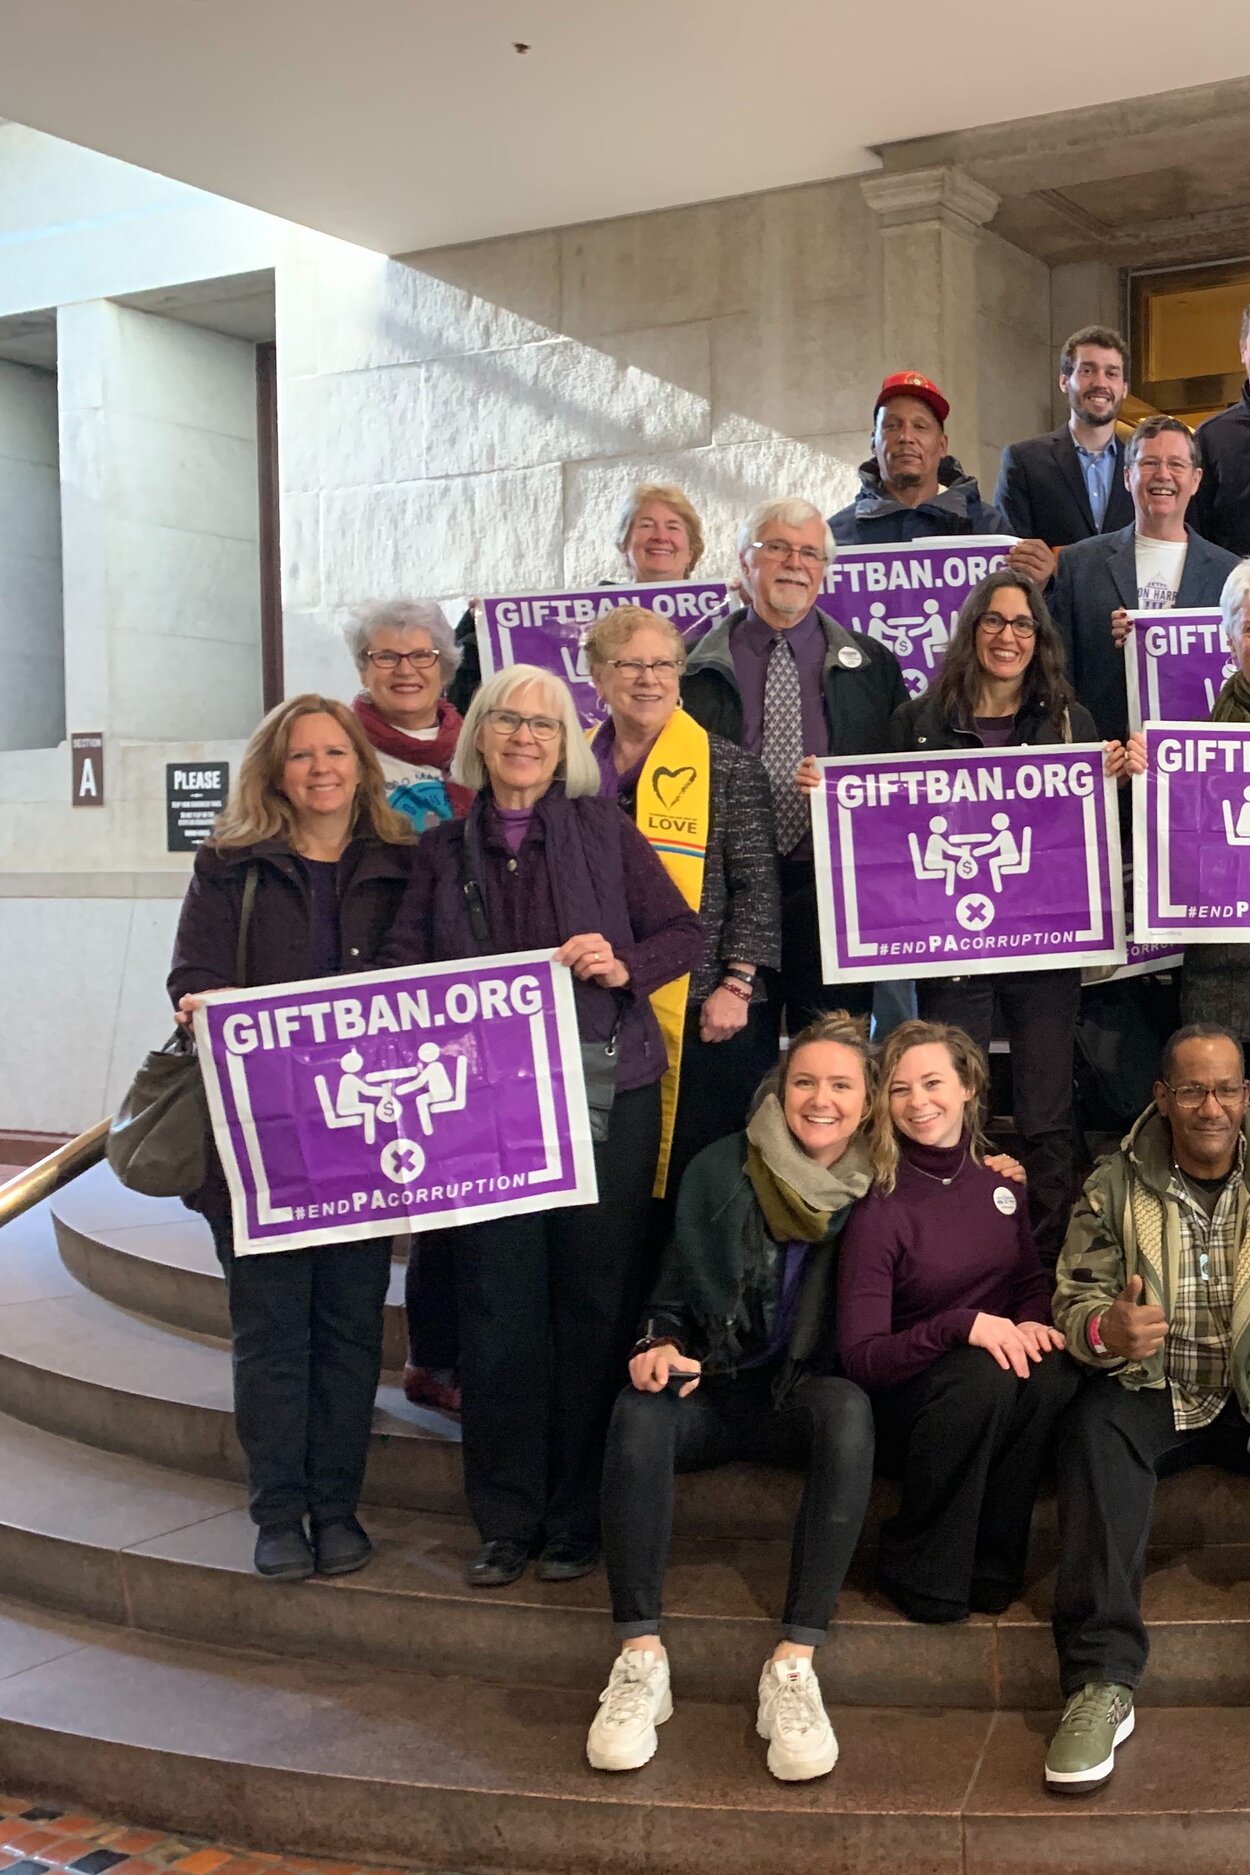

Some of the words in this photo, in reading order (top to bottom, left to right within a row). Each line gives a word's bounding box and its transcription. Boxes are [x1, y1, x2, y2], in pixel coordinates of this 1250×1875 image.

[817, 555, 1007, 594] FTBAN.ORG
[495, 591, 719, 628] GIFTBAORG
[79, 758, 97, 797] A
[173, 770, 221, 790] PLEASE
[837, 761, 1094, 809] GIFTBAN.ORG
[648, 816, 697, 834] LOVE
[879, 931, 1074, 956] #ENDPACORRUPTION
[222, 973, 543, 1056] GIFTBAN.ORG
[292, 1172, 527, 1221] #ENDPACORRUPTION
